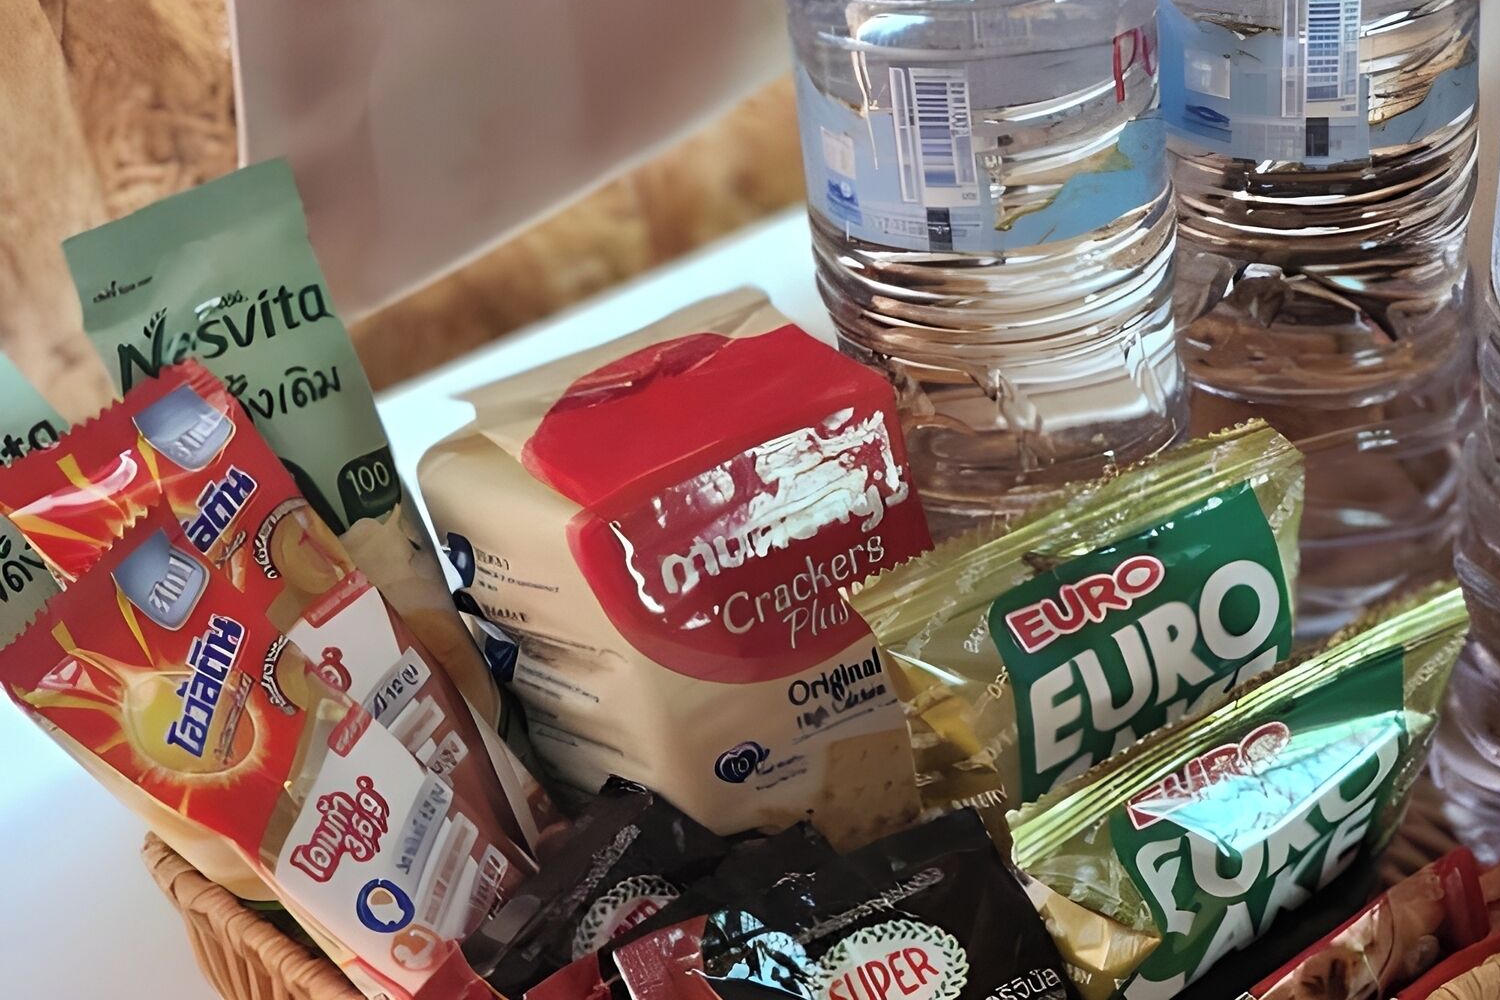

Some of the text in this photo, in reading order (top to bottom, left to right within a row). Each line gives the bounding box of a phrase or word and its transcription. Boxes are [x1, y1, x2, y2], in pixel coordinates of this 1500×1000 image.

[345, 468, 392, 498] 100
[722, 535, 885, 635] Crackers
[1007, 556, 1164, 652] EURO
[788, 646, 882, 706] Original
[1029, 559, 1281, 775] EURO
[827, 946, 940, 1000] SUPER
